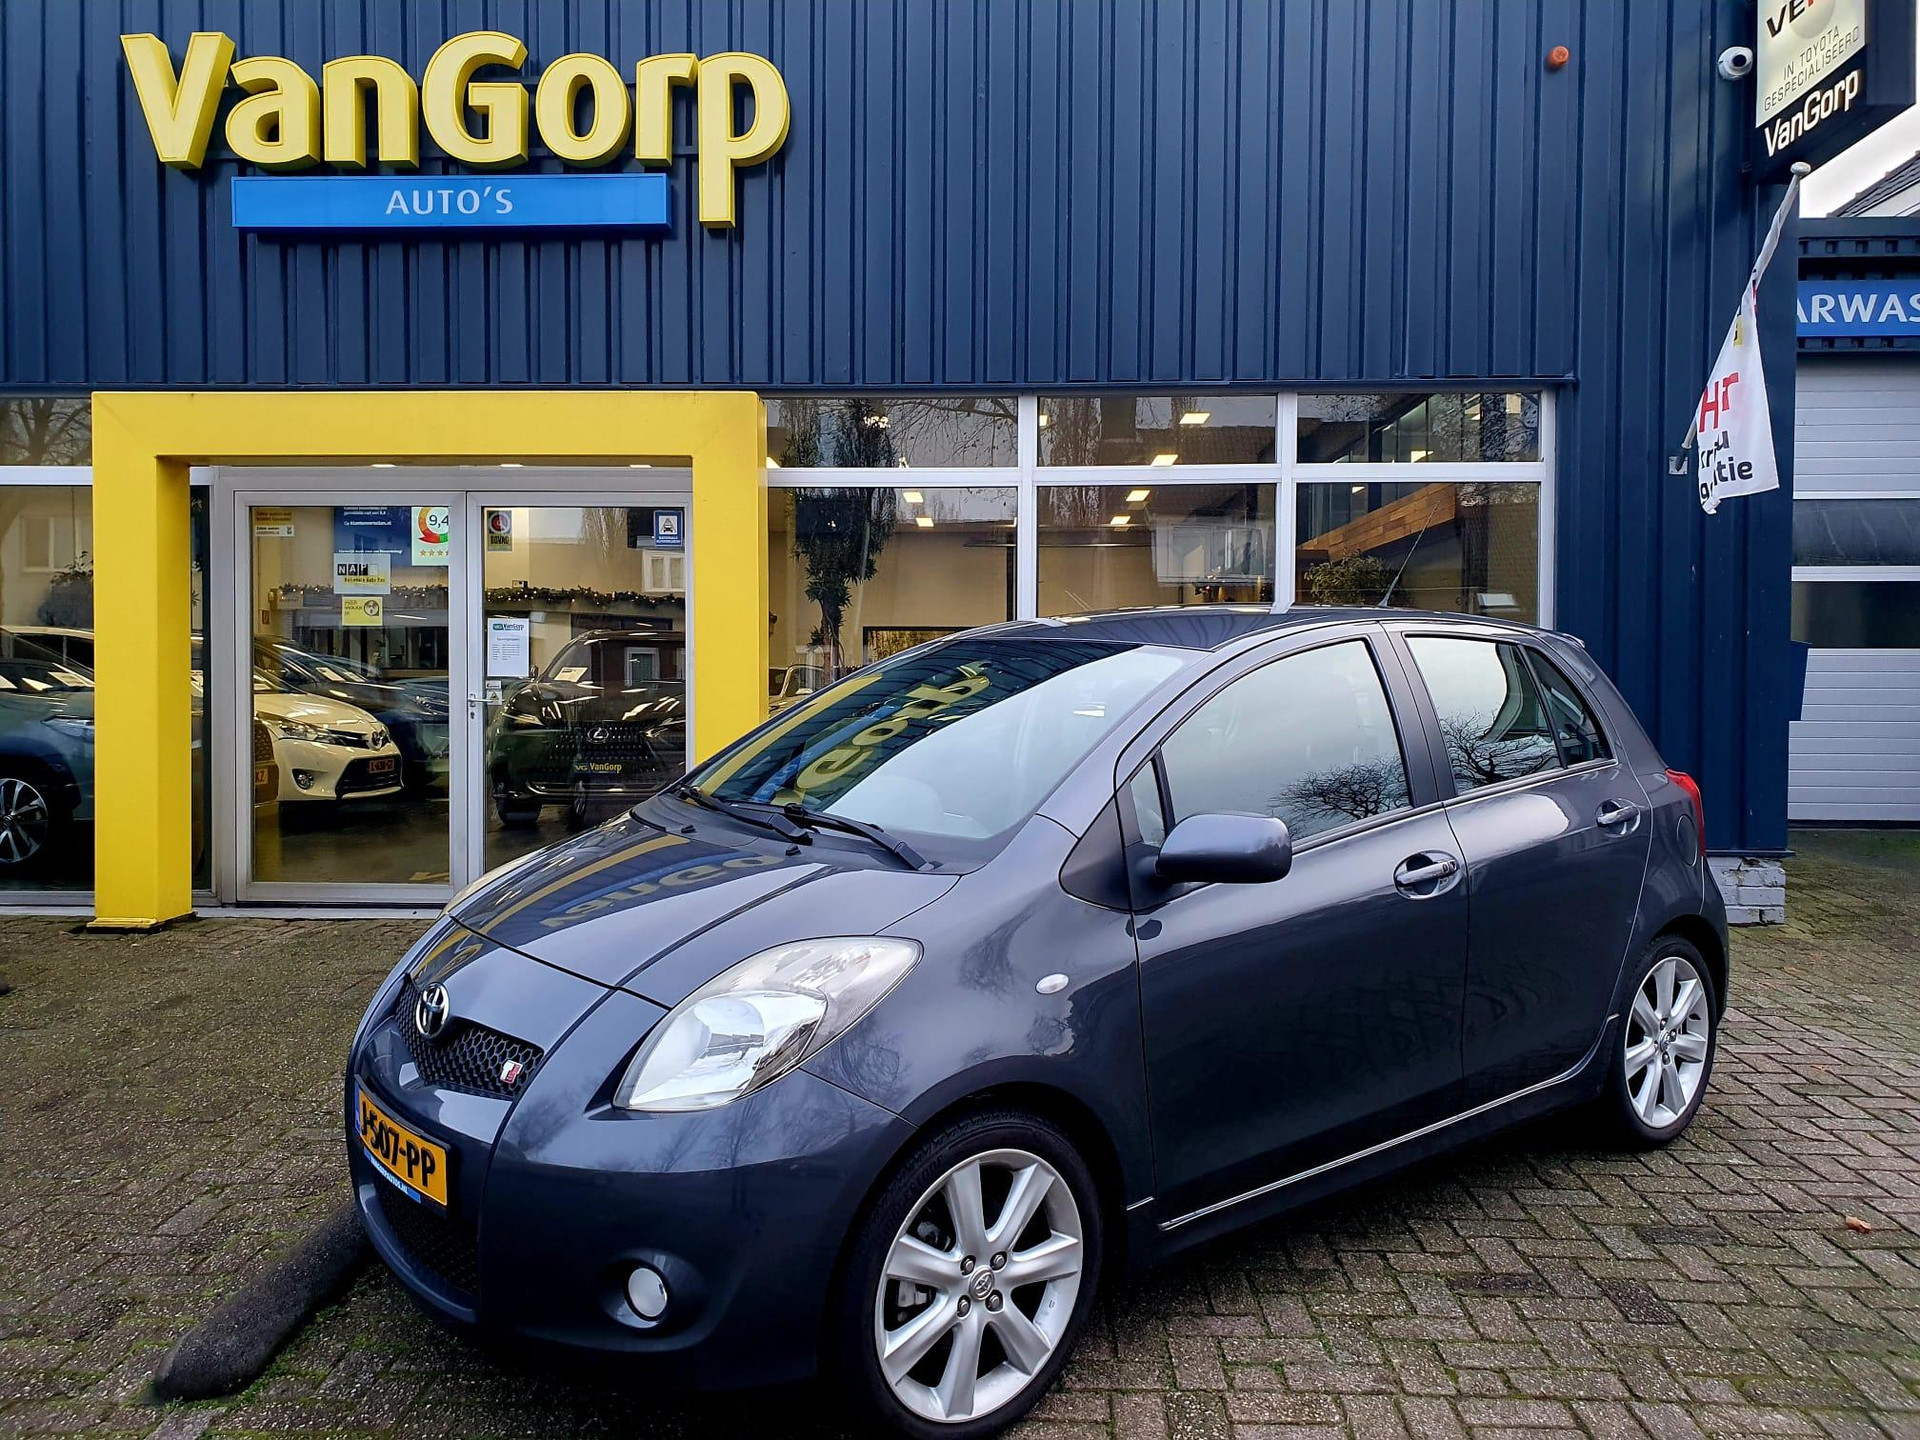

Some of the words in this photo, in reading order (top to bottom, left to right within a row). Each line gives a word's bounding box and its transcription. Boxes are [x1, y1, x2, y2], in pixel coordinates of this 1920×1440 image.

[1764, 26, 1859, 111] GESPECIALISEERD
[1783, 61, 1794, 80] IN
[1800, 25, 1839, 67] TOYOTA
[120, 31, 790, 229] VanGorp
[1764, 70, 1860, 158] VanGorp
[386, 187, 513, 215] AUTO'S
[589, 762, 622, 773] VanGorp
